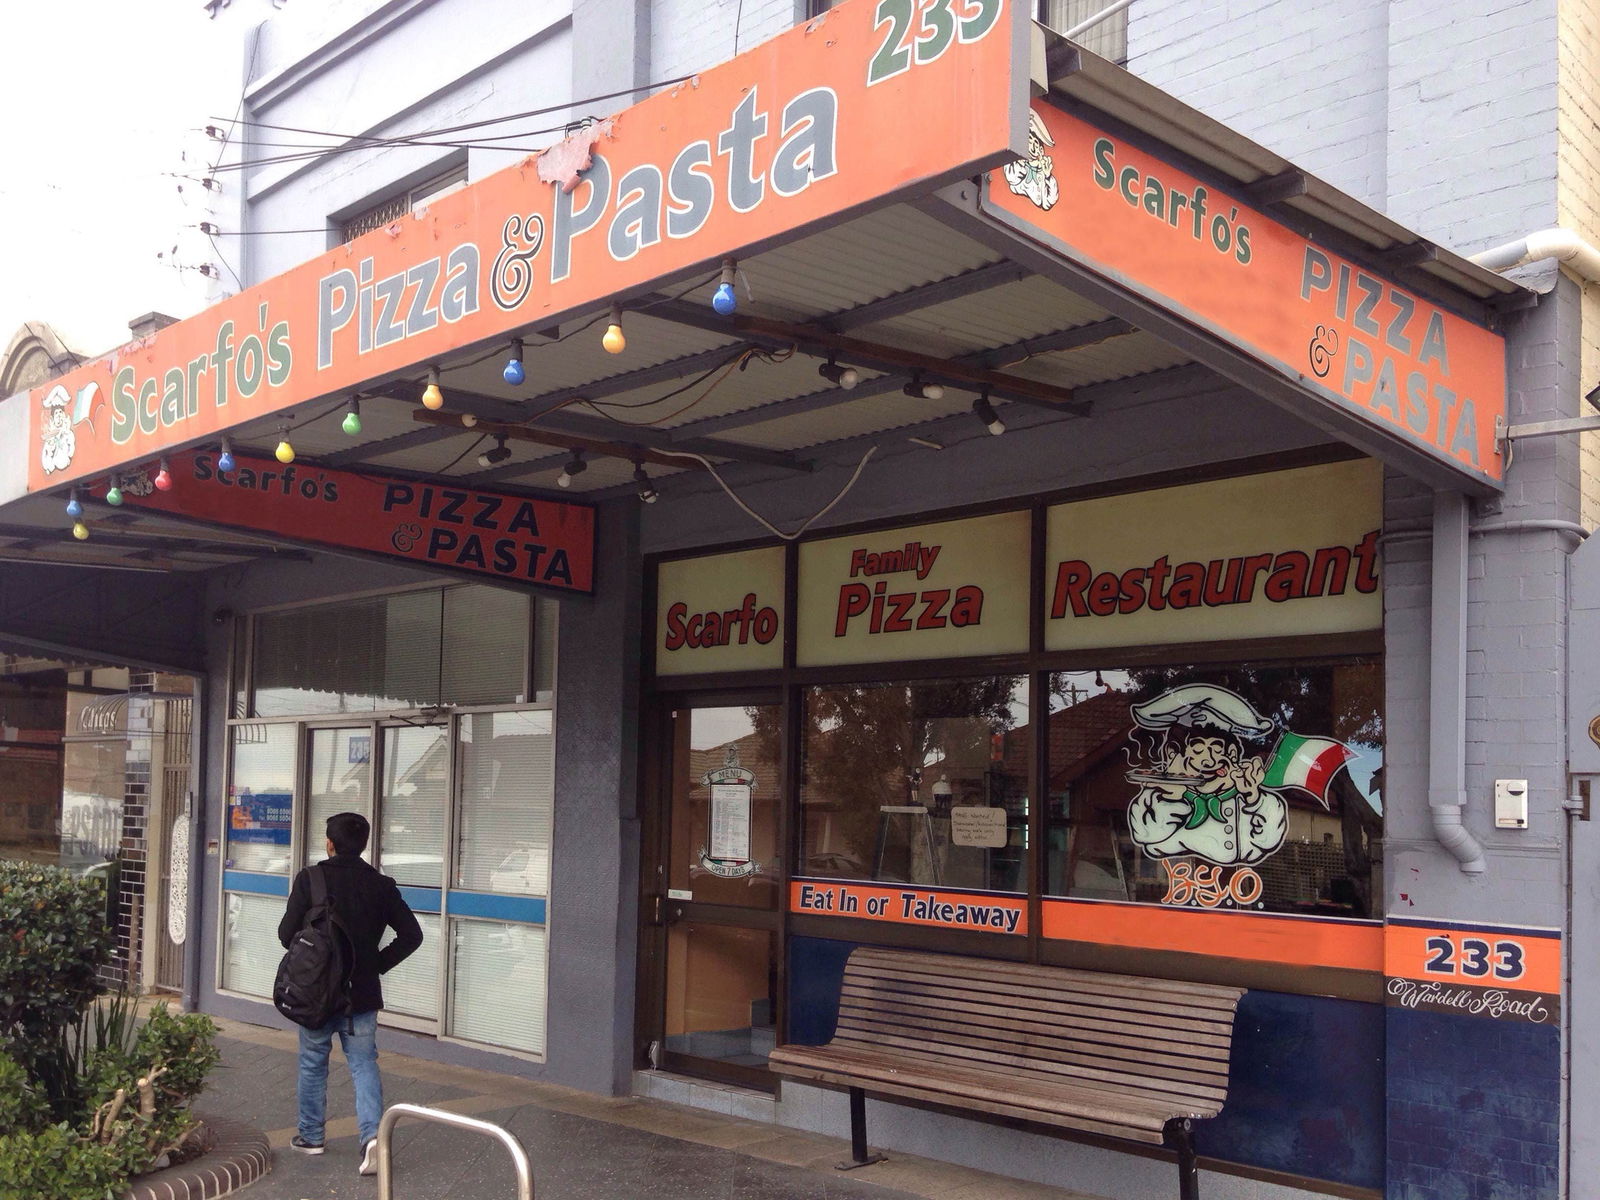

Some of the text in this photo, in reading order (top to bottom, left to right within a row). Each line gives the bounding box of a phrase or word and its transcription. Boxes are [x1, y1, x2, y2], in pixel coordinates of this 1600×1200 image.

[1093, 138, 1253, 267] Scarfo's
[111, 303, 292, 445] Scarfo's
[318, 242, 481, 371] Pizza
[491, 213, 545, 311] &
[551, 85, 839, 285] Pasta
[1300, 244, 1451, 377] PIZZA
[1309, 324, 1480, 466] & PASTA
[194, 455, 339, 502] Scarfo's
[383, 482, 540, 537] PIZZA
[392, 523, 573, 585] & PASTA
[849, 542, 942, 580] Family
[1051, 528, 1382, 620] Restaurant
[665, 594, 778, 652] Scarfo
[835, 583, 985, 639] Pizza
[718, 769, 742, 778] MENU
[726, 867, 731, 876] 7
[799, 884, 1022, 933] Eat In or Takeaway
[1424, 935, 1527, 982] 233
[1387, 977, 1548, 1023] Wardell Road
